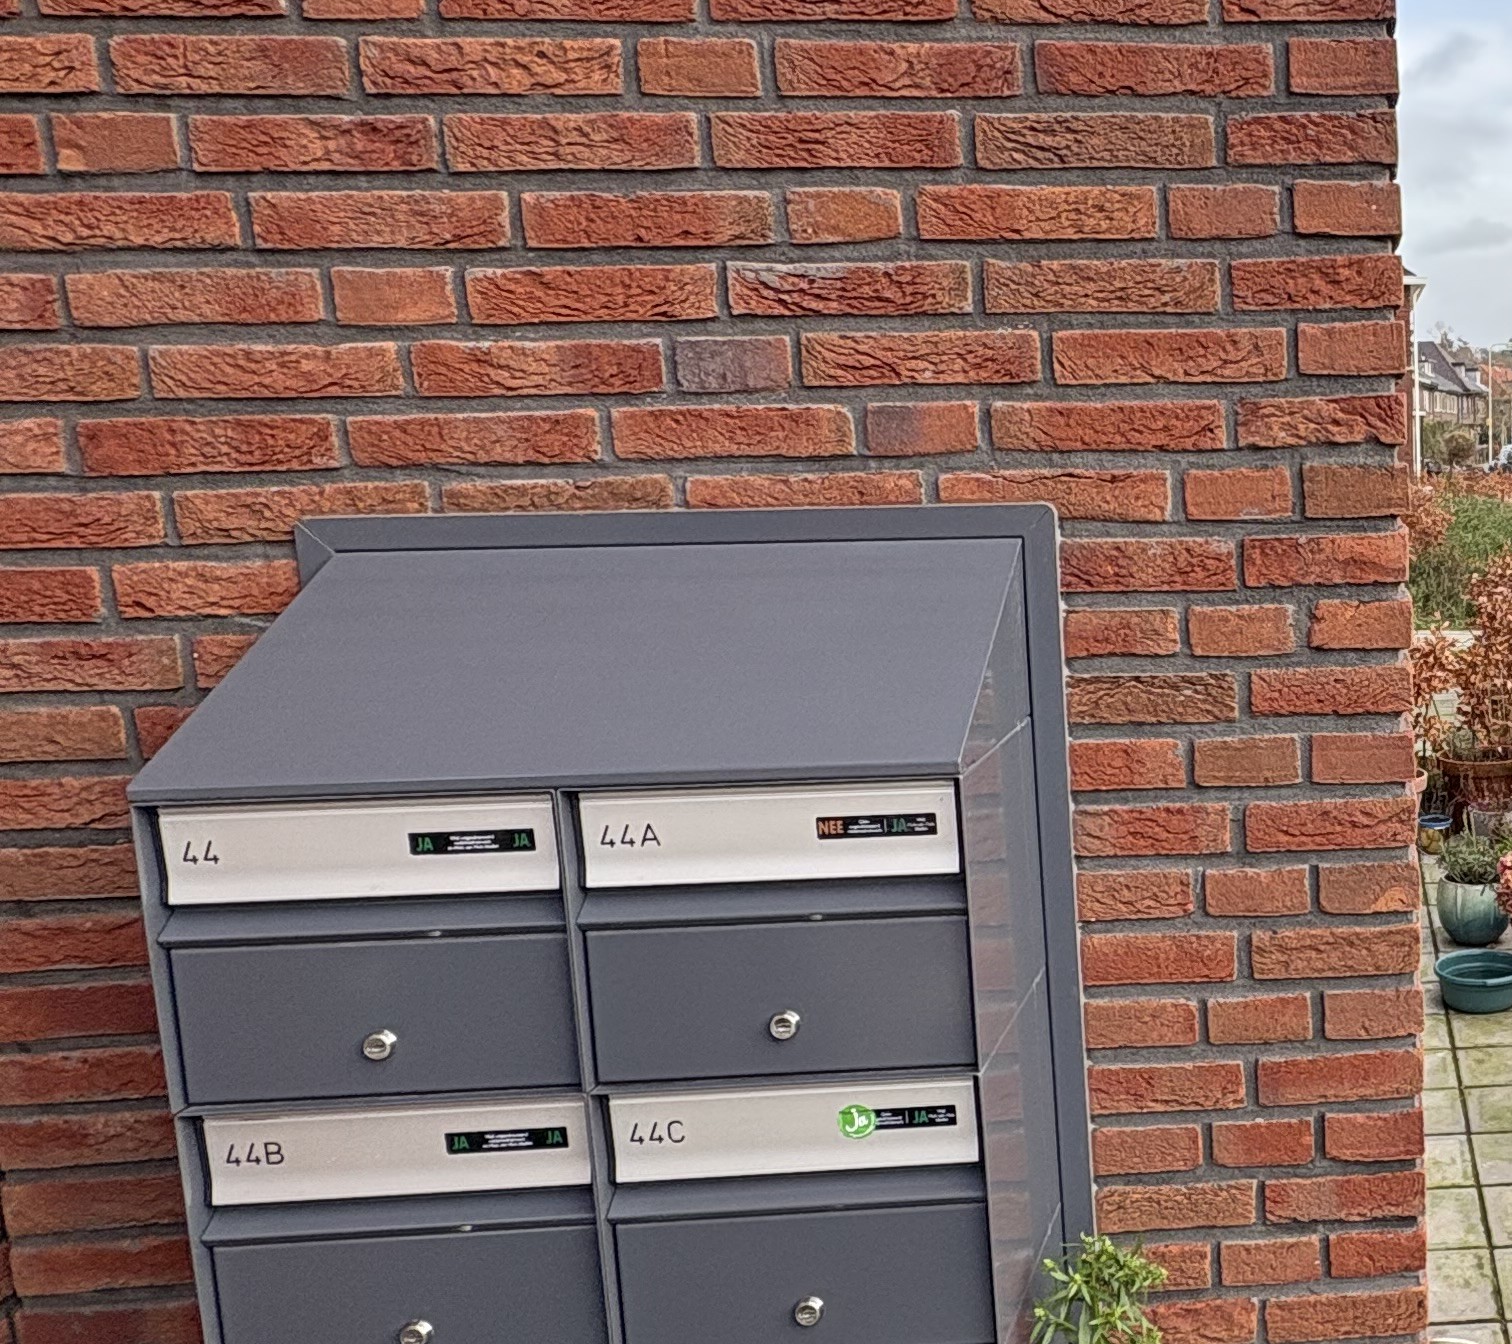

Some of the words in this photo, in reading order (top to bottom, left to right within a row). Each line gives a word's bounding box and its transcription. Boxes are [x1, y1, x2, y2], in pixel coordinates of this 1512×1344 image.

[818, 820, 844, 835] NEE
[891, 818, 908, 832] JA
[513, 833, 531, 847] JA
[601, 823, 661, 848] 44A
[416, 837, 434, 851] JA
[183, 841, 219, 865] 44
[912, 1110, 929, 1123] JA
[546, 1130, 563, 1144] JA
[630, 1120, 686, 1145] 44C
[452, 1136, 470, 1150] JA
[226, 1142, 285, 1167] 44B
